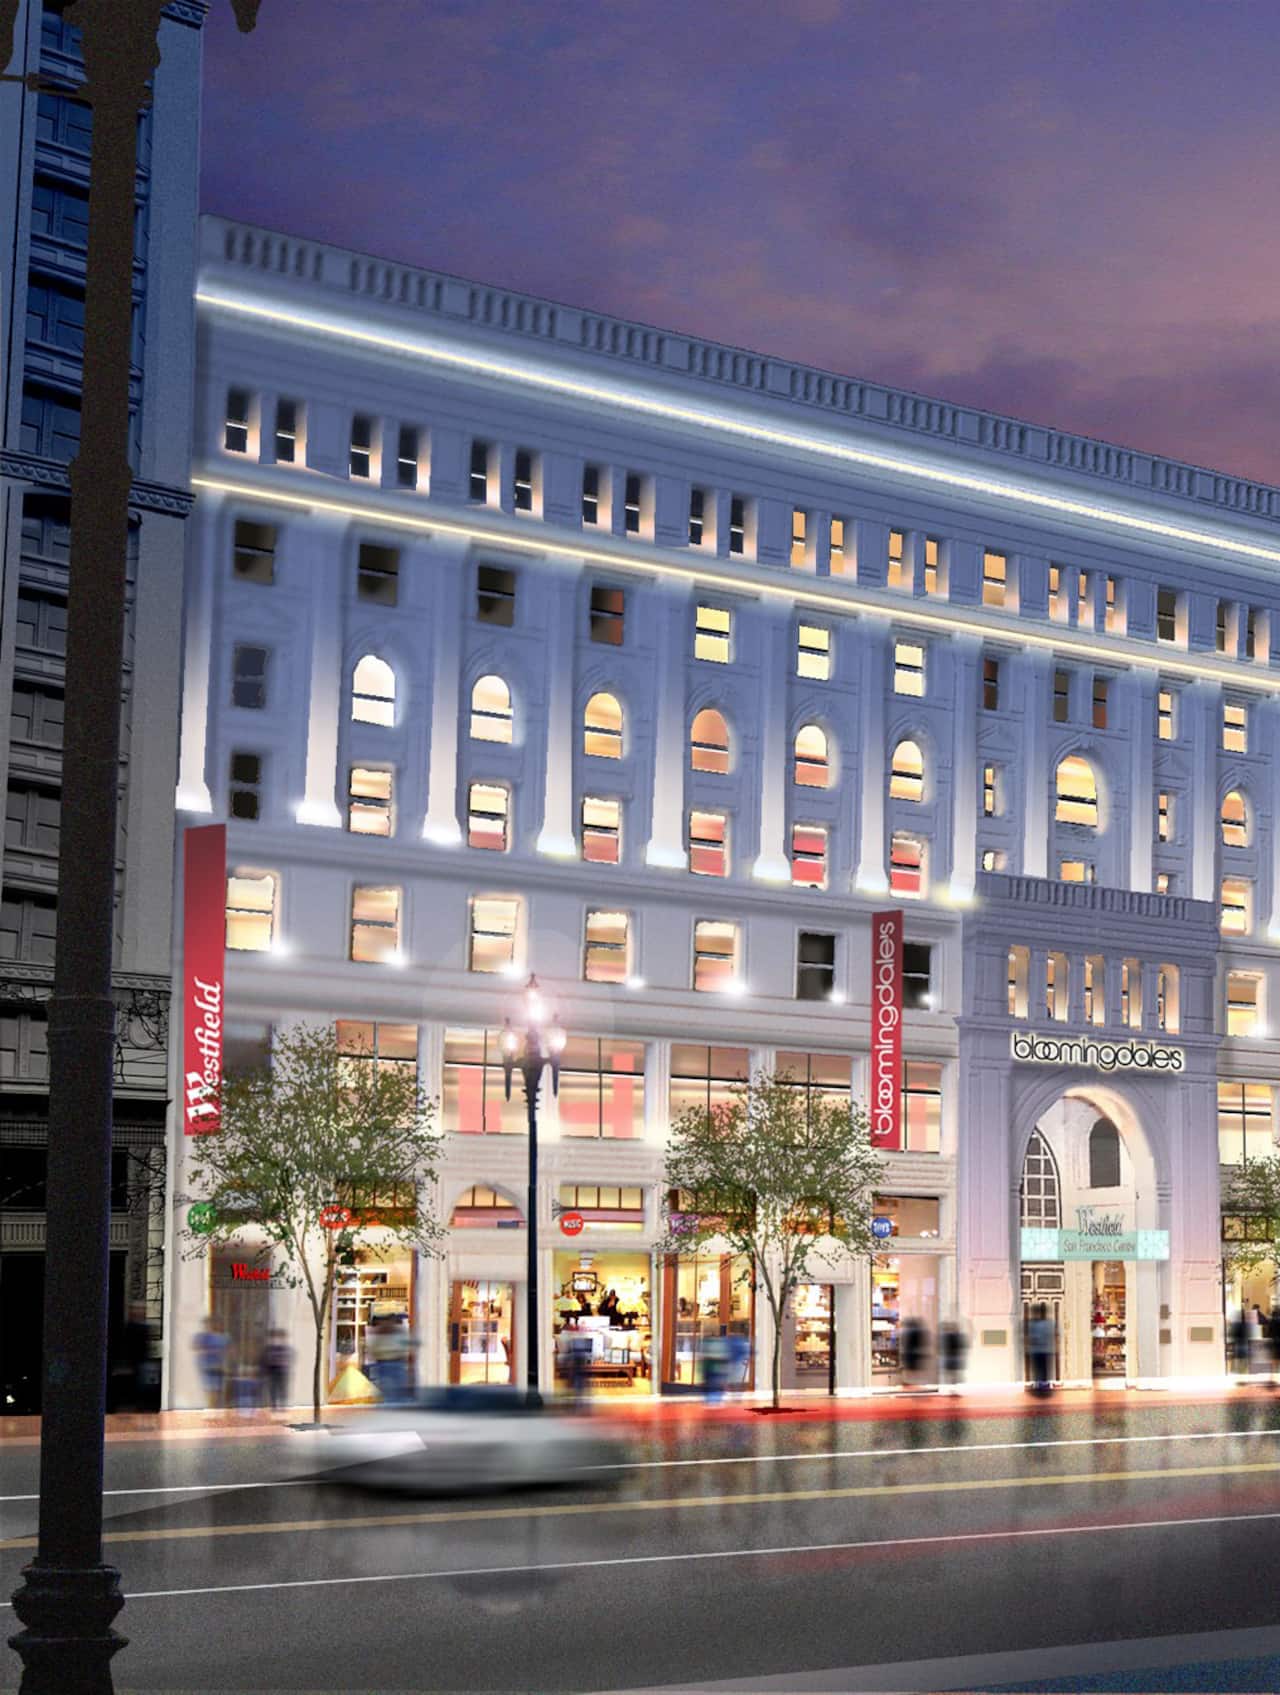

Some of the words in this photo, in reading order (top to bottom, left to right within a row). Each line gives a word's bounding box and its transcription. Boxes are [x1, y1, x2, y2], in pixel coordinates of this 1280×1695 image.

[184, 975, 222, 1123] Westfield
[874, 921, 899, 1136] bloomingdale's
[1012, 1032, 1185, 1072] bloomingdale's
[1075, 1207, 1125, 1237] Westfield
